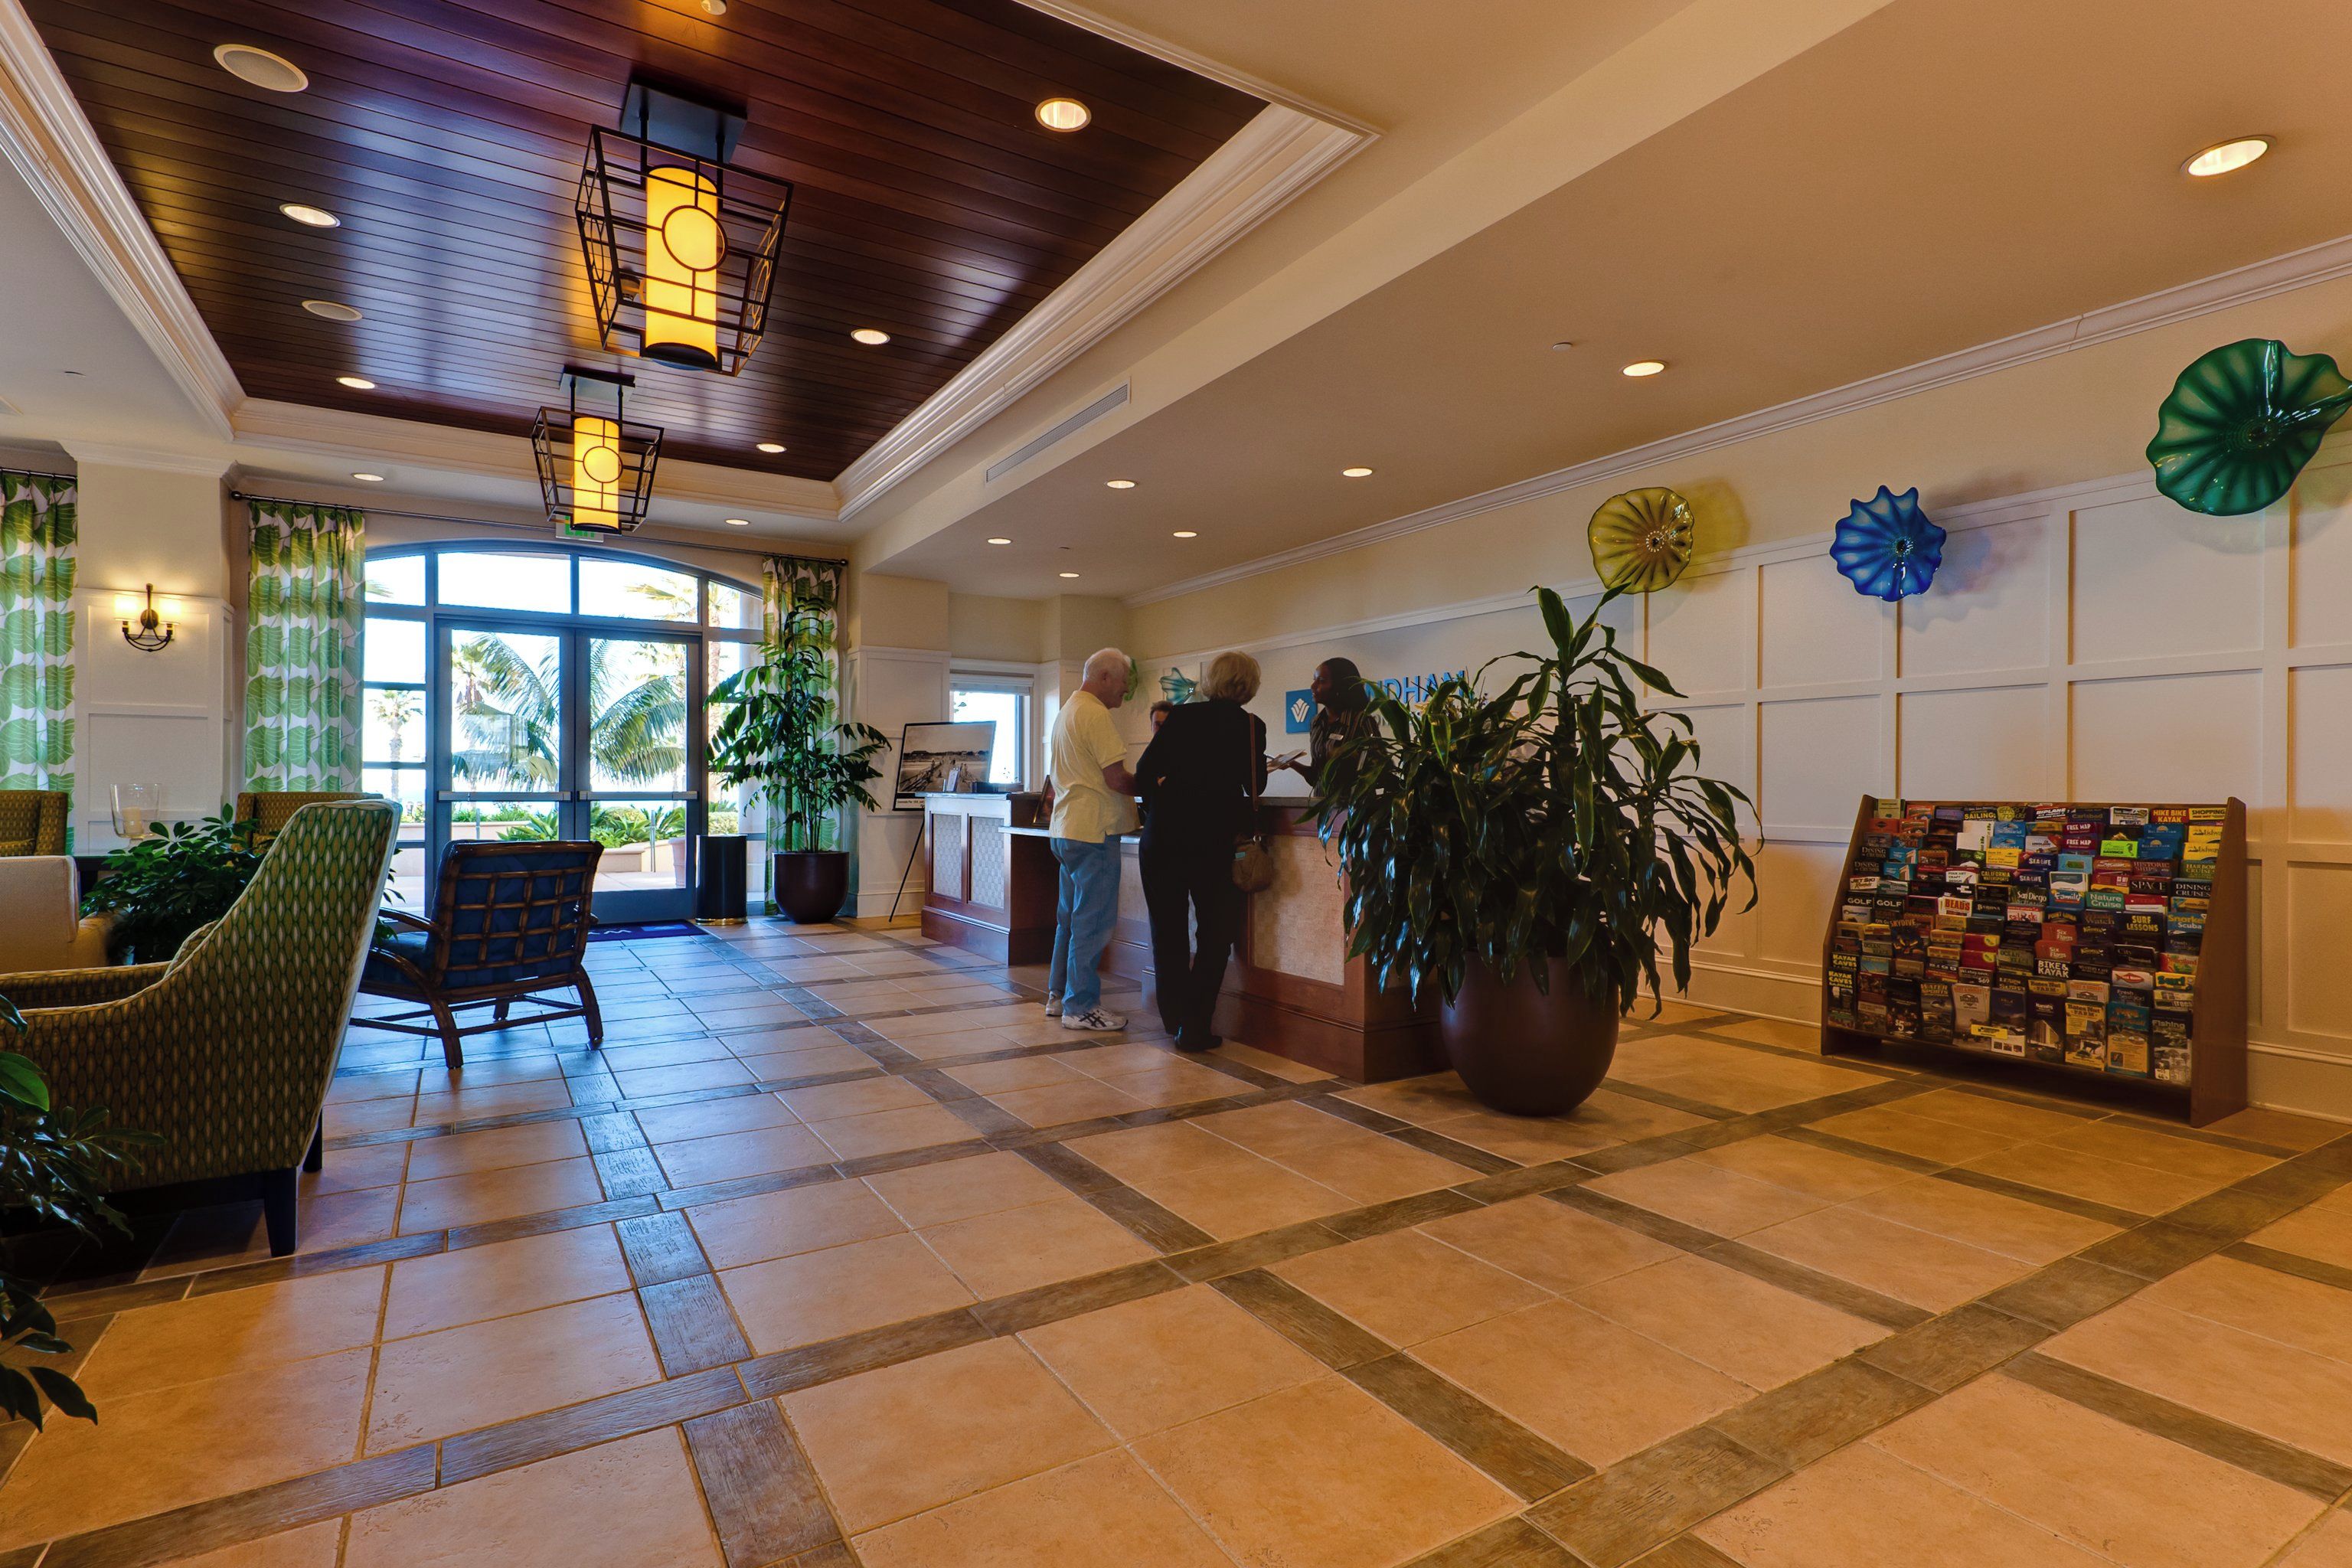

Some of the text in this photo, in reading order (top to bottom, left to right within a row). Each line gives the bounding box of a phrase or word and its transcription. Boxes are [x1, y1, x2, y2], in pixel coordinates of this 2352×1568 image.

[1364, 670, 1465, 704] NDHAM
[1861, 846, 1886, 854] DINING
[2132, 881, 2166, 890] SPACE
[2029, 892, 2047, 902] Diego
[2055, 892, 2082, 901] Family
[2091, 893, 2122, 902] Nature
[1945, 899, 1970, 910] BEADS
[2091, 900, 2122, 908] Cruise
[1890, 919, 1917, 927] SKYDIVE
[2132, 915, 2151, 923] SURF
[2126, 923, 2159, 932] LESSONS
[1833, 959, 1857, 968] CAVES
[1828, 970, 1852, 978] KAYAK
[2038, 967, 2069, 978] KAYAK
[1828, 976, 1853, 985] CAVES
[1895, 1019, 1904, 1031] $5
[2151, 1019, 2185, 1029] Fishing
